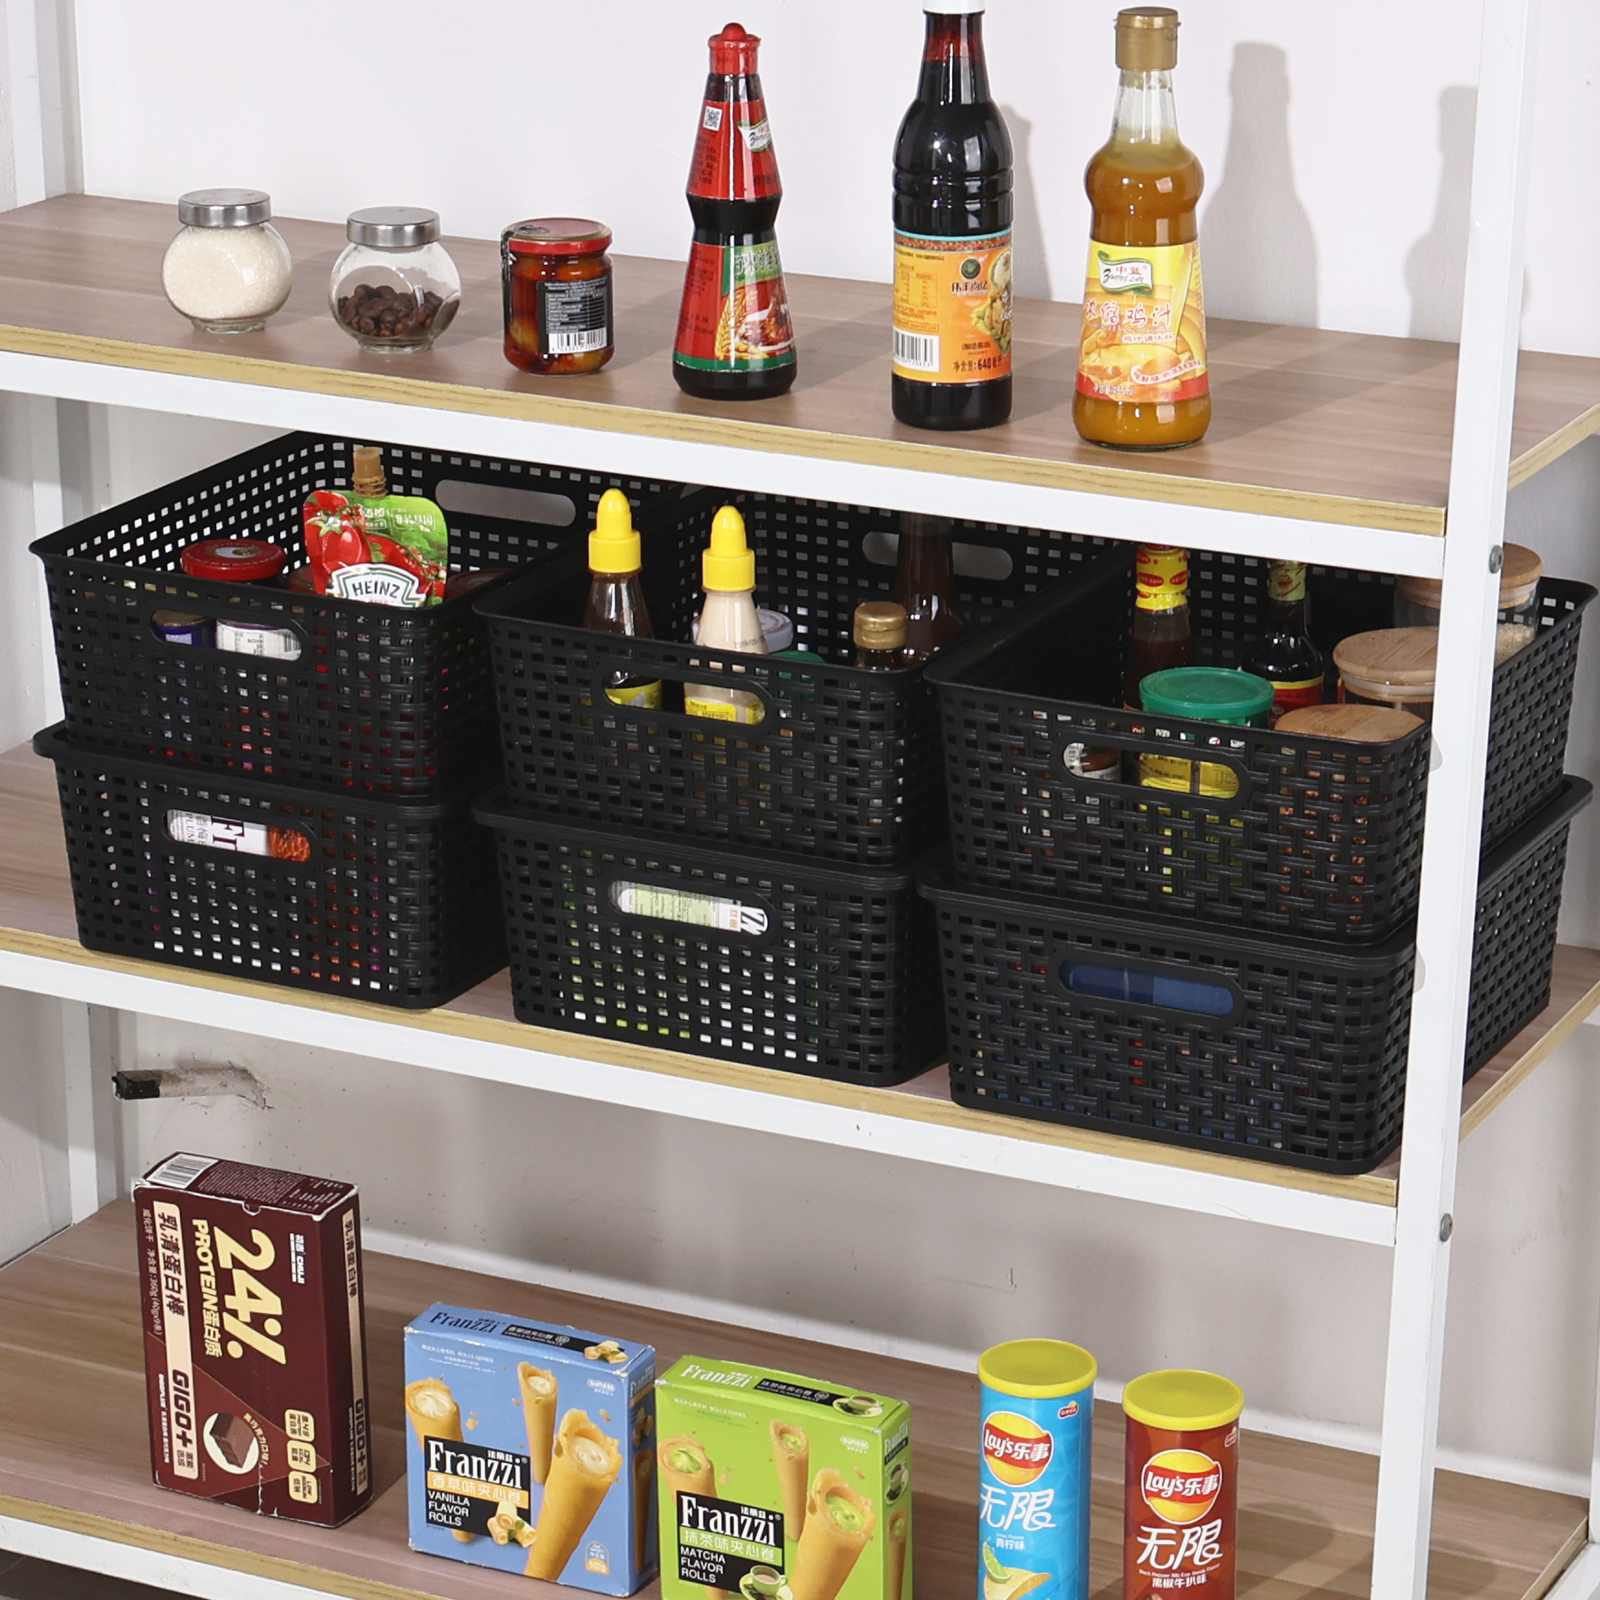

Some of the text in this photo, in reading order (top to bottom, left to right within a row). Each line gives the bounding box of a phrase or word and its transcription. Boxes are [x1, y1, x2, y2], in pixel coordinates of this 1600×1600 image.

[351, 580, 401, 599] HEINZ
[158, 1212, 185, 1317] 乳清蛋白棒
[213, 1225, 287, 1365] 24%
[430, 1311, 500, 1334] Franzzi
[680, 1364, 754, 1388] Franzzi
[428, 1440, 522, 1489] Franzzi
[428, 1490, 470, 1507] VANILLA
[432, 1475, 522, 1505] 香草味夹心卷
[428, 1501, 469, 1517] FLAVOR
[980, 1482, 1057, 1531] 无限
[429, 1511, 462, 1527] ROLLS
[680, 1495, 775, 1546] Franzzi
[681, 1547, 726, 1564] MATCHA
[684, 1529, 775, 1561] 抹茶味夹心卷
[1136, 1518, 1223, 1570] 无限
[681, 1557, 724, 1574] FLAVOR
[681, 1567, 717, 1583] ROLLS
[1152, 1574, 1208, 1589] 黑椒牛扒味
